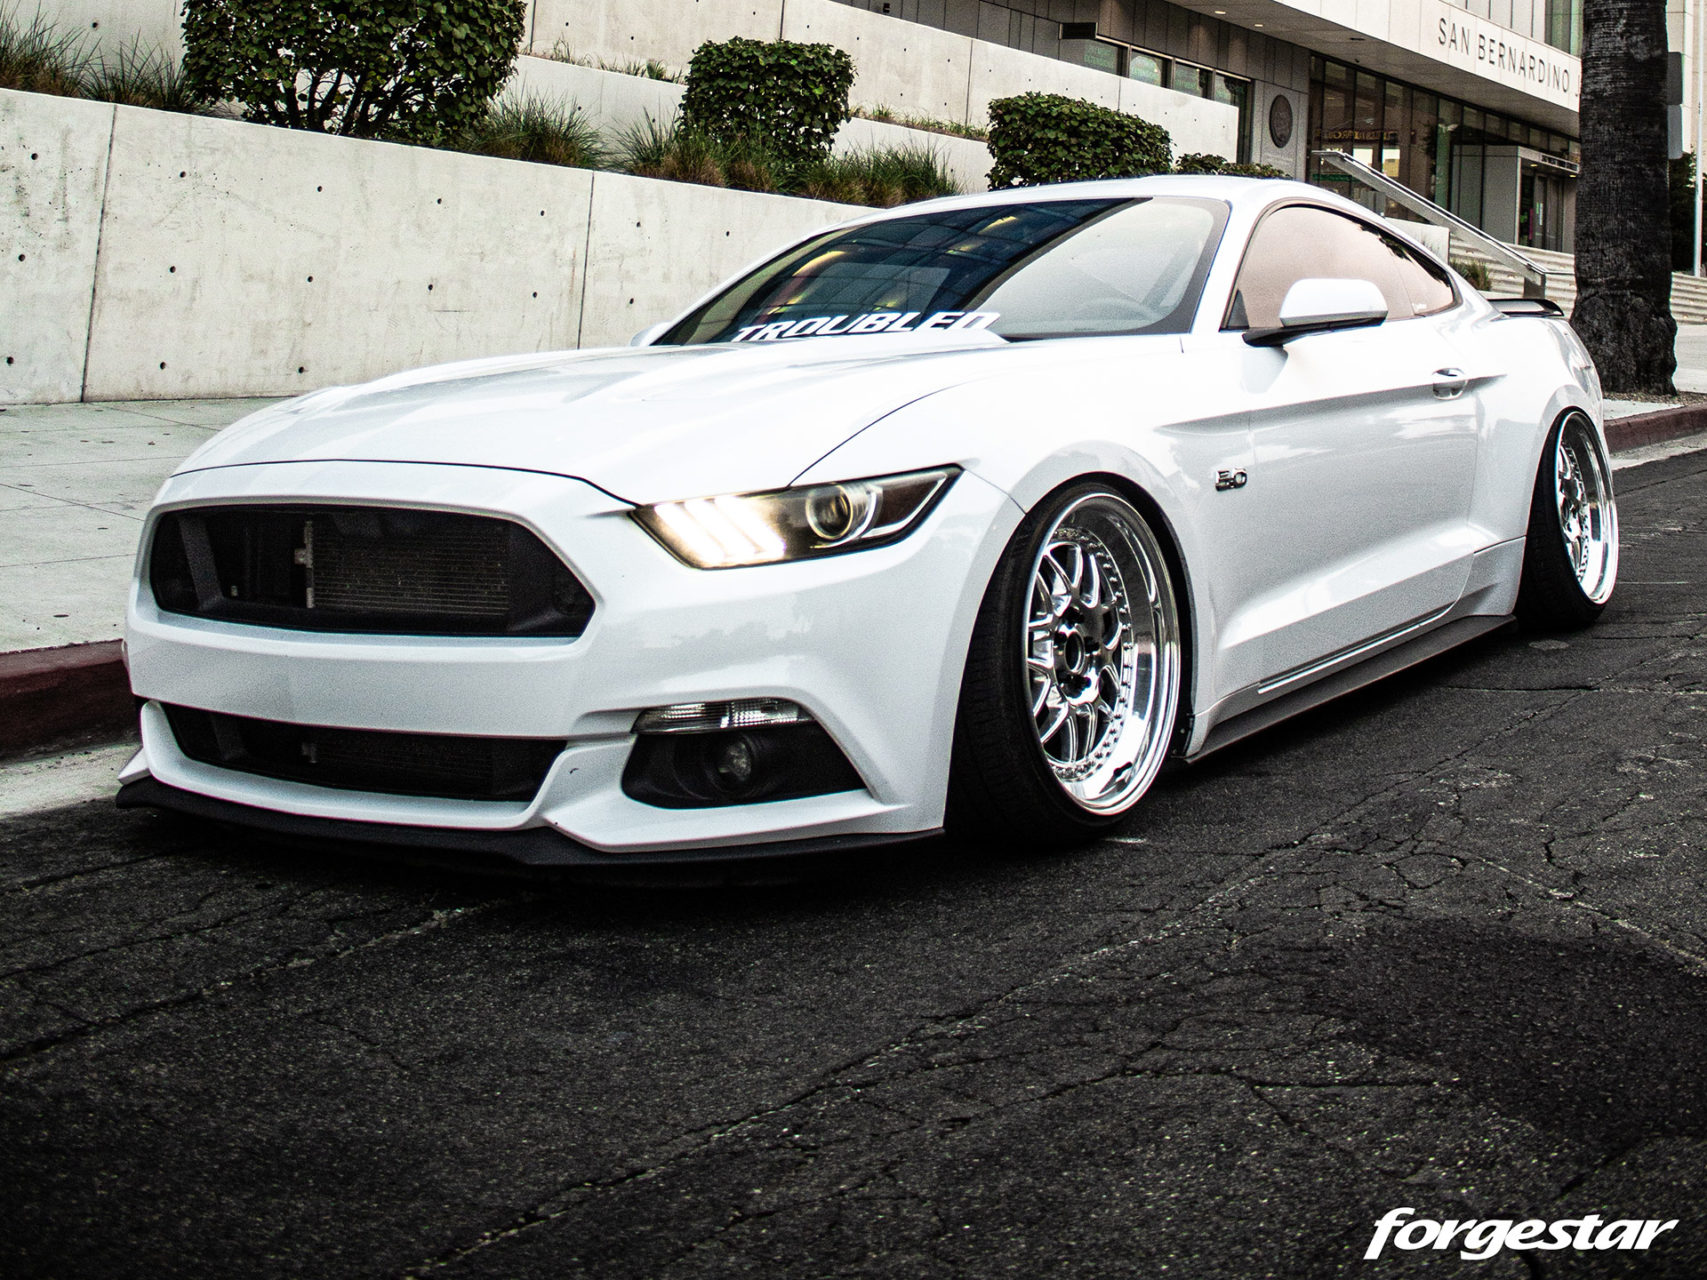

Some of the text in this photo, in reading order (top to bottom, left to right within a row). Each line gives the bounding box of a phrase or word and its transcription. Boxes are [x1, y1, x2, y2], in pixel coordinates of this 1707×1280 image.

[1438, 17, 1471, 56] SAN
[1477, 33, 1570, 93] BERNARDINO
[731, 311, 1000, 343] TROUBLED
